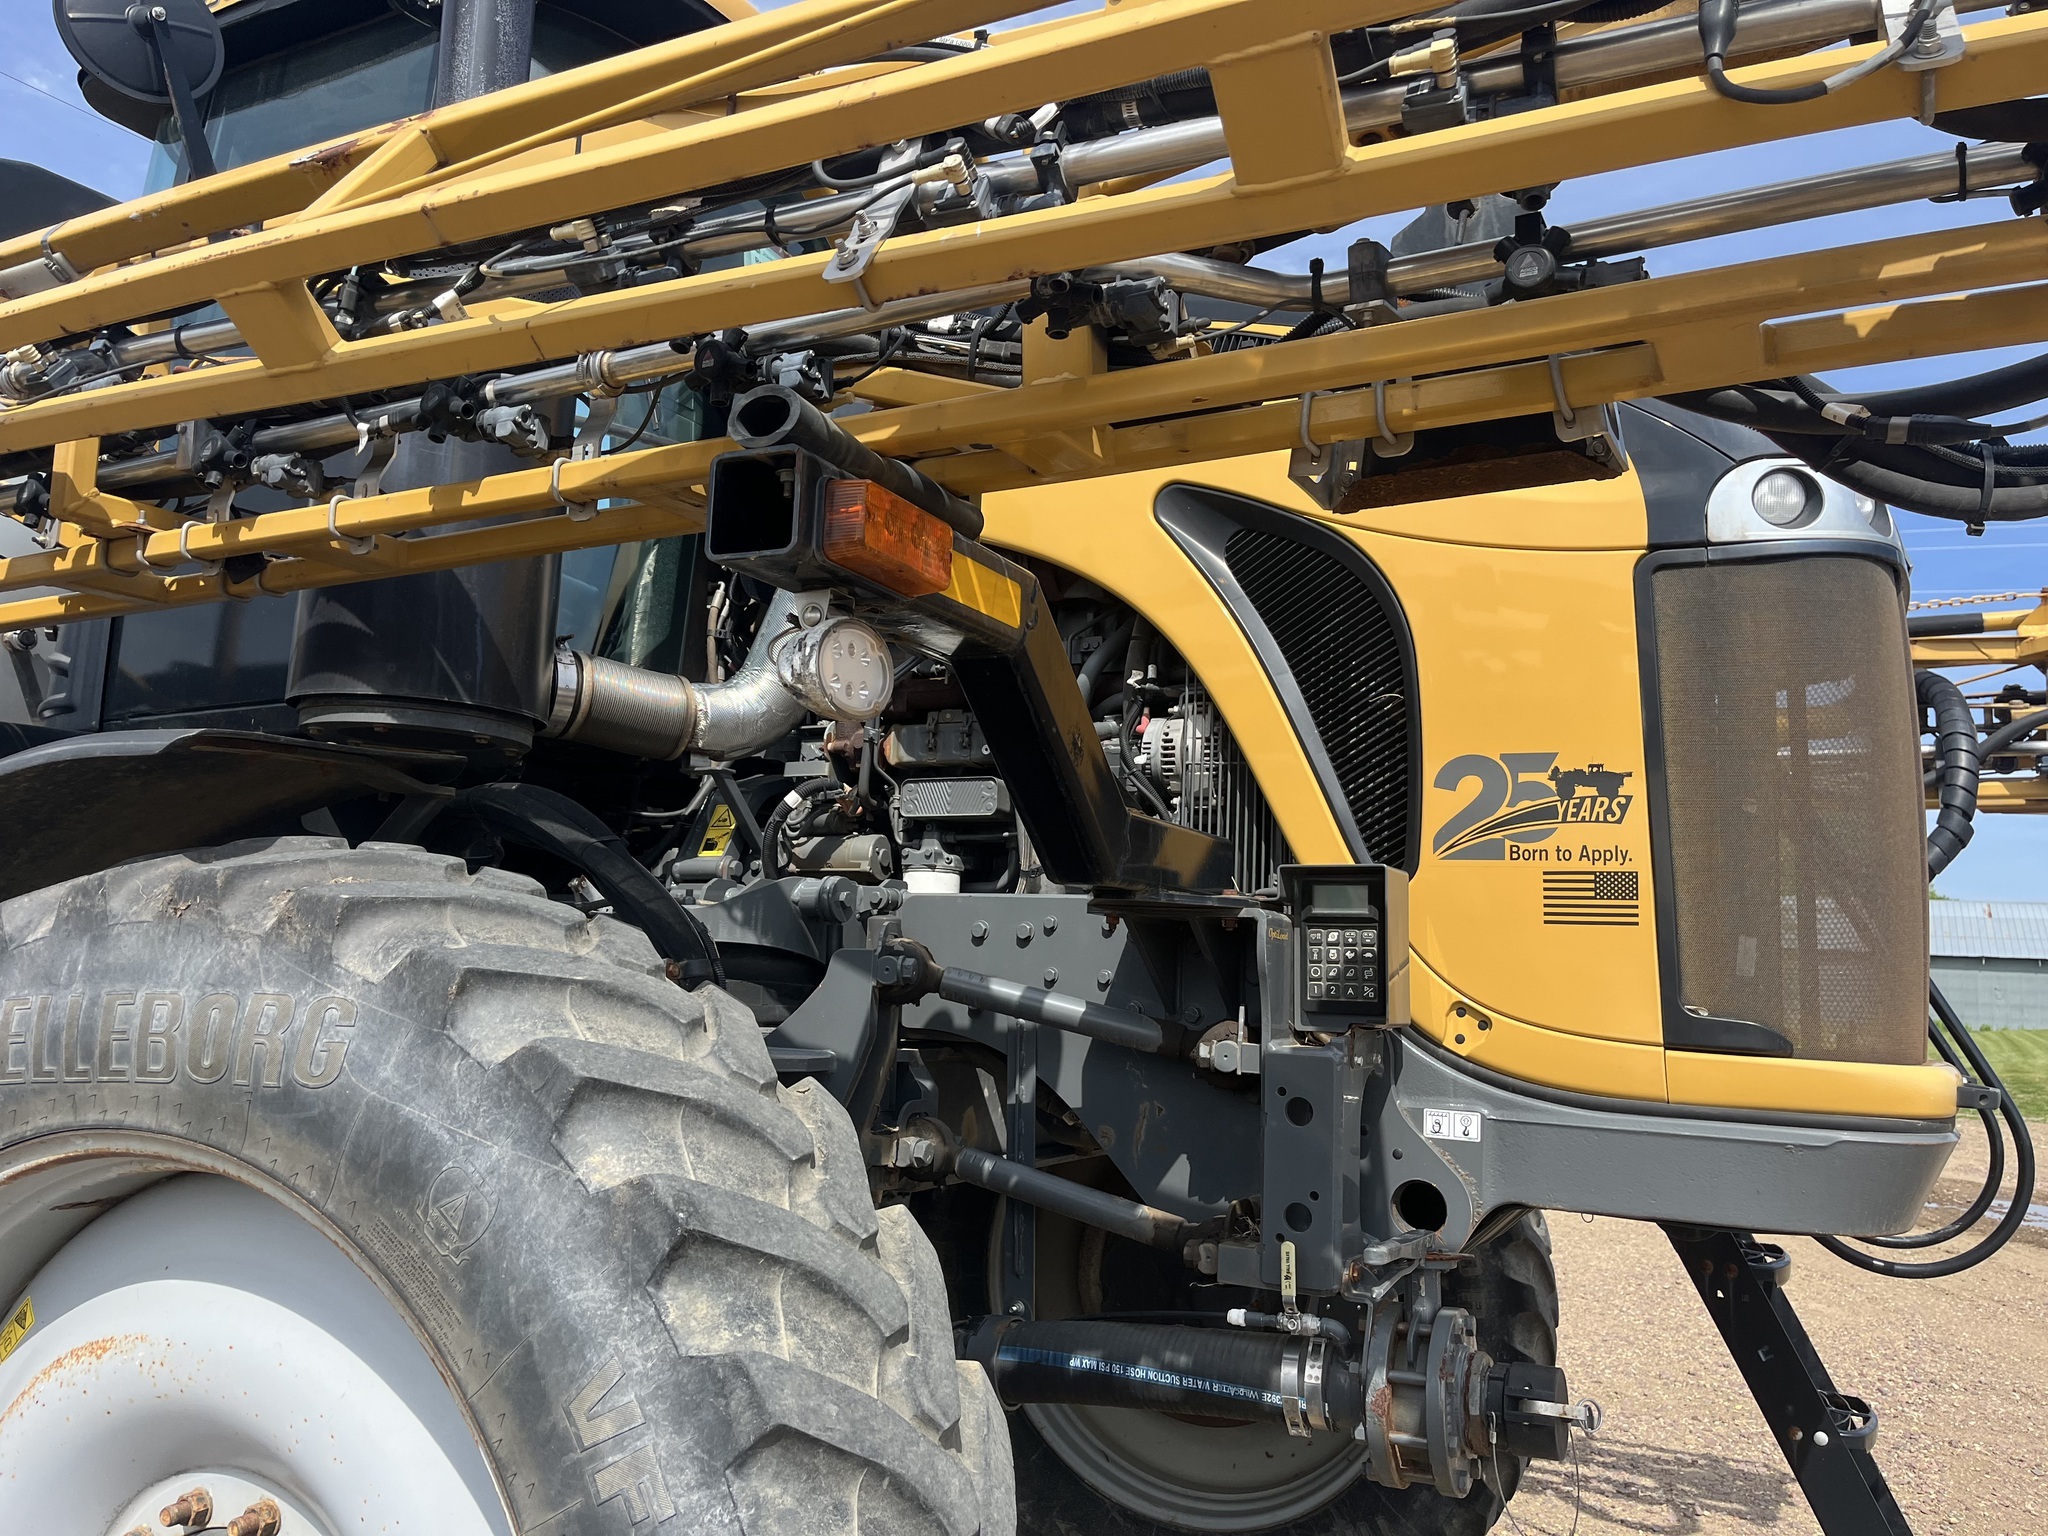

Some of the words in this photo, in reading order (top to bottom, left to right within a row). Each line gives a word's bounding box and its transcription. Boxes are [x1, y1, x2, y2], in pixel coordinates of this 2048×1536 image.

[1433, 752, 1559, 861] 25
[1556, 796, 1627, 822] YEARS
[1509, 844, 1549, 861] Born
[1555, 845, 1573, 862] to
[1578, 844, 1633, 866] Apply.
[0, 990, 359, 1089] ELLEBORG
[1069, 1357, 1081, 1368] WP
[1081, 1358, 1097, 1370] MAX
[1098, 1361, 1110, 1372] PSI
[1111, 1363, 1124, 1375] 150
[1125, 1366, 1146, 1378] HOSE
[1147, 1370, 1181, 1386] SUCTION
[1182, 1377, 1211, 1391] WATER
